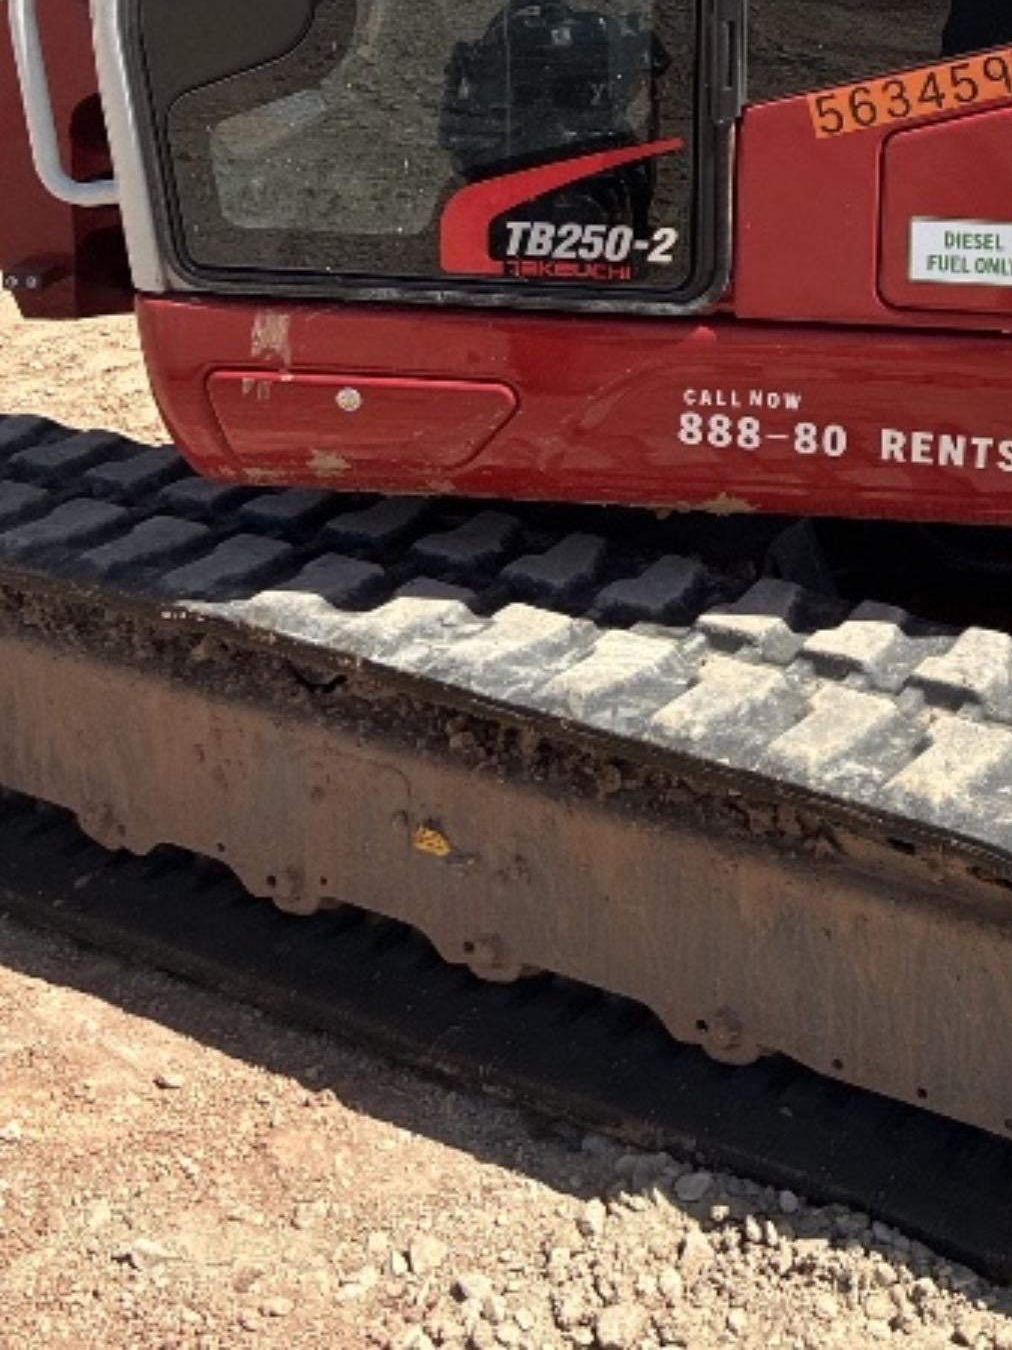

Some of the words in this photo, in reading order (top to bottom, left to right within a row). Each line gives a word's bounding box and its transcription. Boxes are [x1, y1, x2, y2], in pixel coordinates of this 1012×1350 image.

[815, 56, 1012, 134] 563459
[506, 221, 679, 263] TB250-2
[944, 230, 1004, 251] DIESEL
[507, 260, 631, 280] TAKEUCHI
[926, 254, 970, 274] FUEL
[683, 389, 742, 408] CALL
[750, 390, 801, 410] NOW
[678, 411, 847, 457] 888-80
